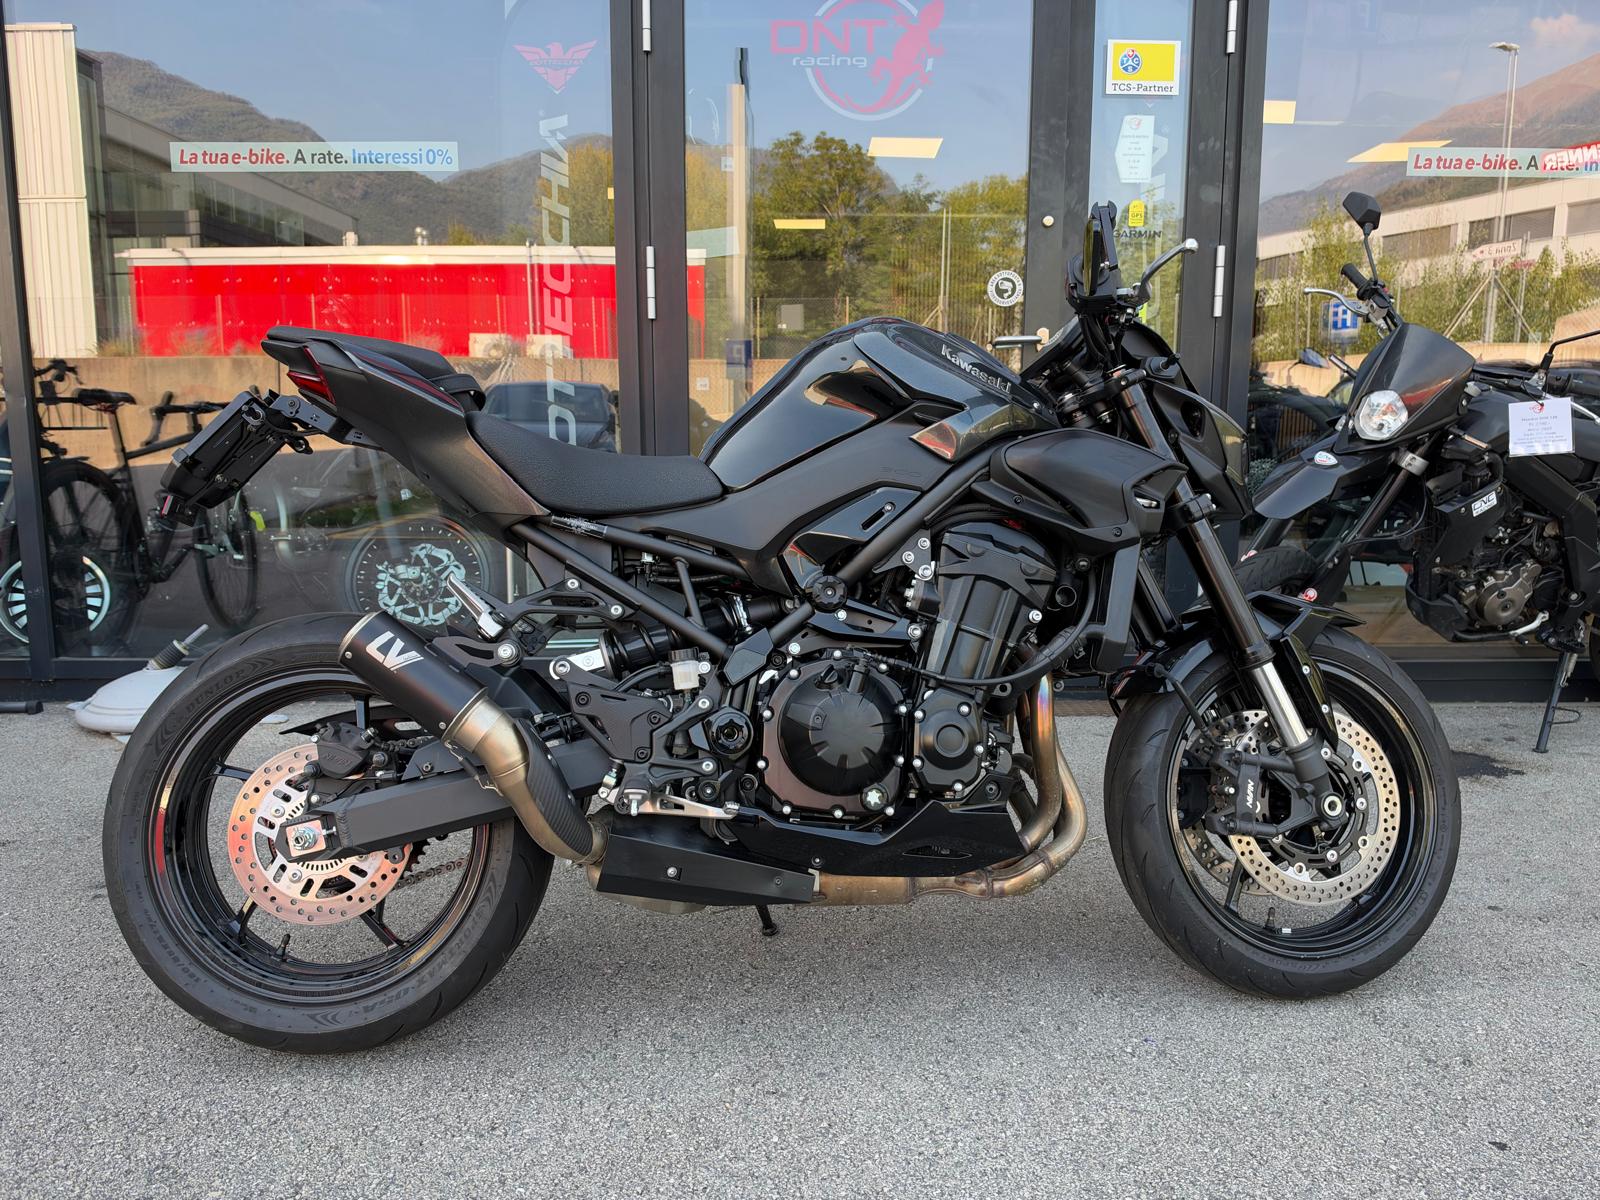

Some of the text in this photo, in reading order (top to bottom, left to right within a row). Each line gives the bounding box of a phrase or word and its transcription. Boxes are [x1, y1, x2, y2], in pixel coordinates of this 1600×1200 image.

[792, 54, 868, 68] racing
[1111, 83, 1174, 93] TCS-Partner
[179, 148, 453, 165] La tua e-bike. A rate. Interessi 0%
[1413, 154, 1433, 170] La
[1436, 155, 1463, 170] tua
[1465, 154, 1523, 171] e-bike.
[1526, 155, 1539, 171] A
[1113, 230, 1163, 239] GARMIN
[941, 343, 1012, 394] Kawasaki
[366, 630, 423, 670] LV
